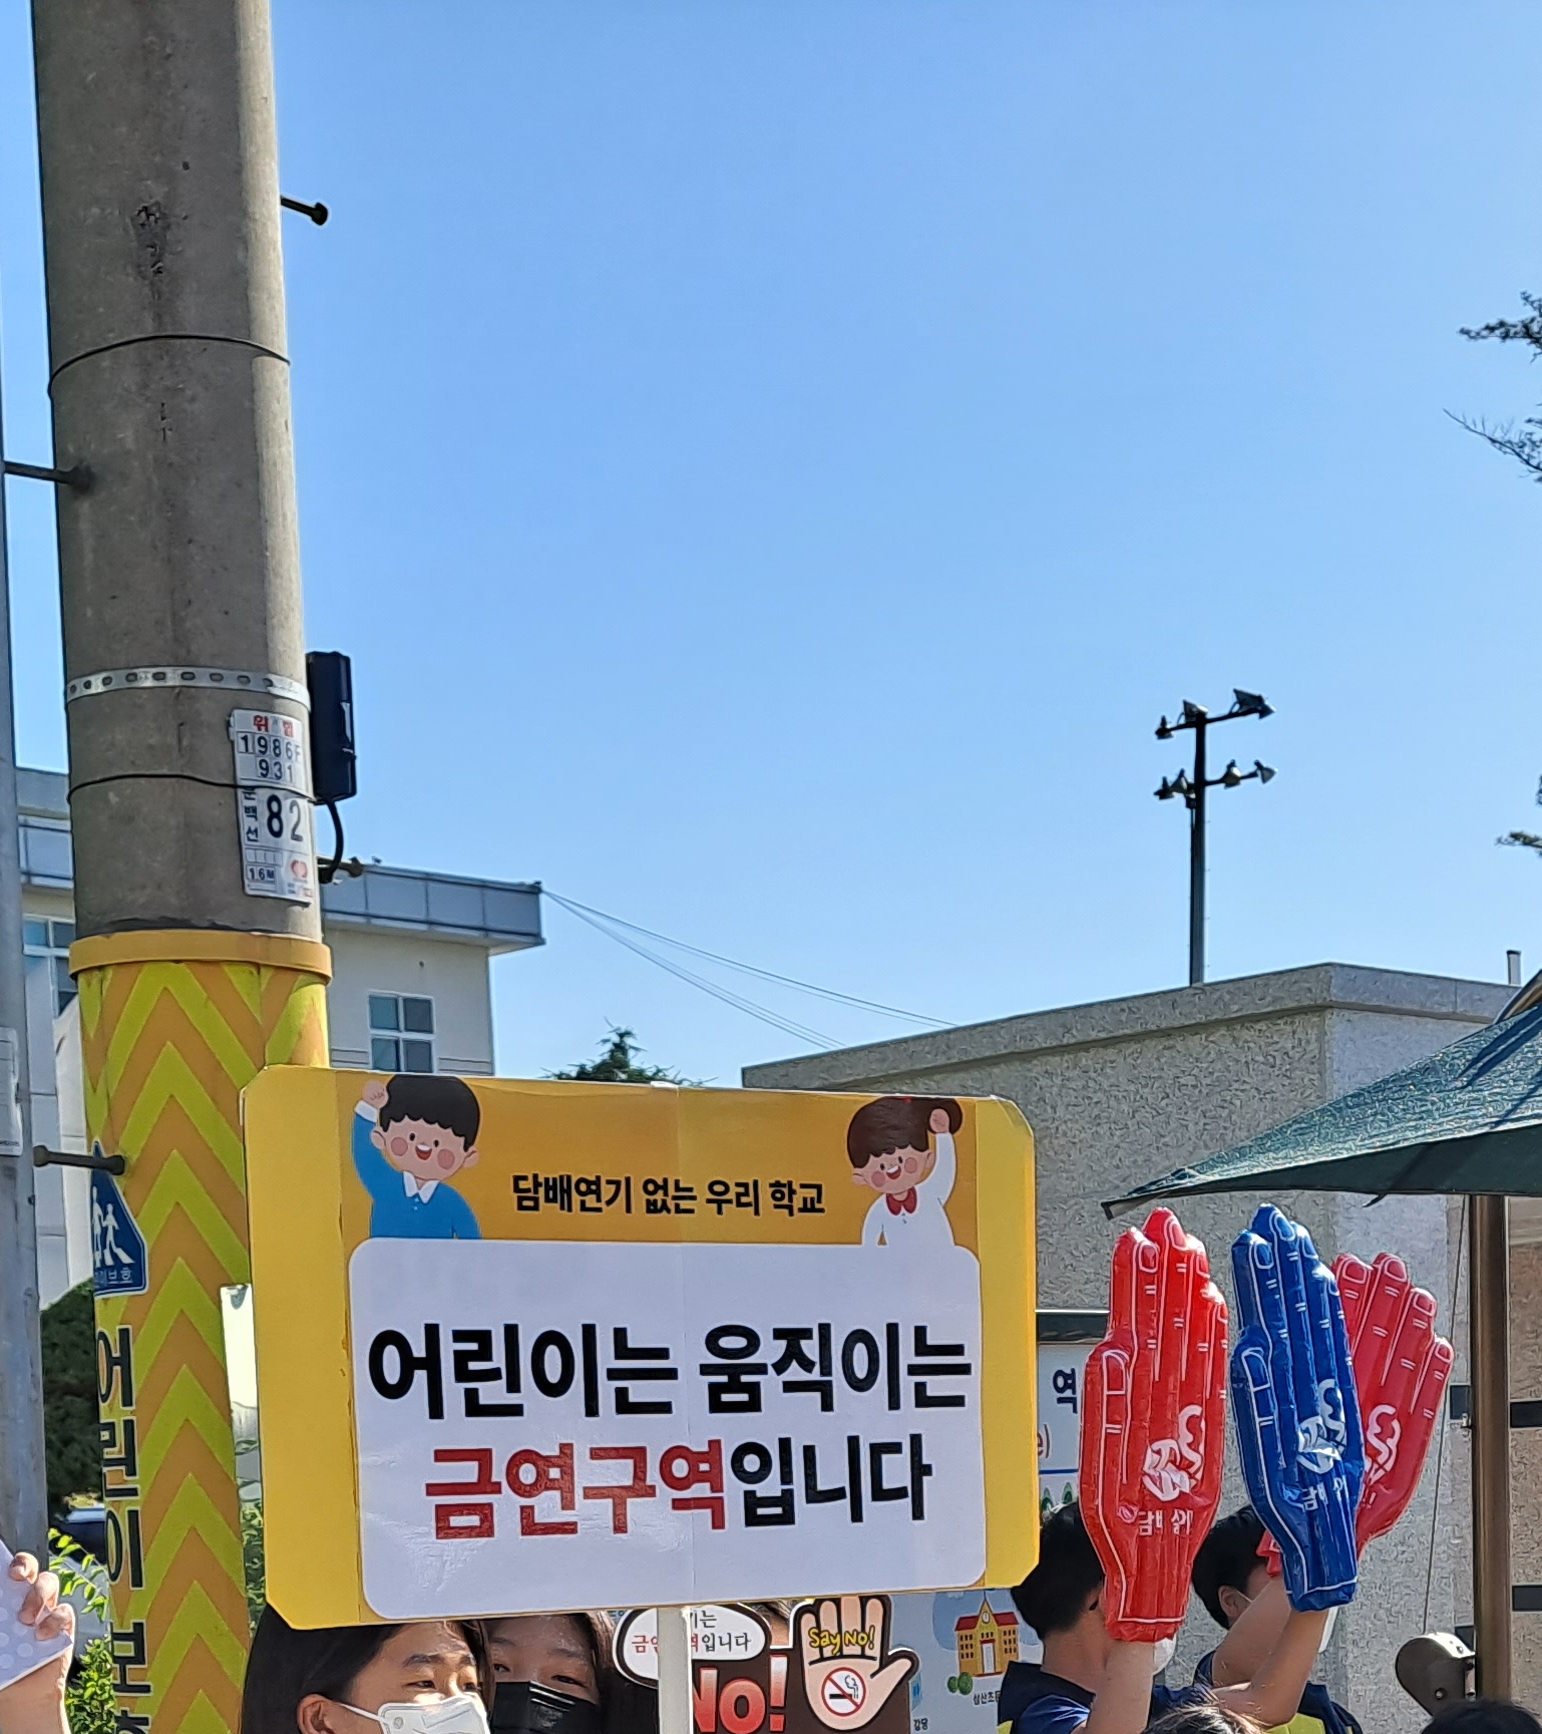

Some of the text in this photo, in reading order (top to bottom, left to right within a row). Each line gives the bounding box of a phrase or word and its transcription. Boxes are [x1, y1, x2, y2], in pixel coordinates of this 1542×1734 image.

[258, 758, 295, 784] 931
[267, 794, 303, 842] 82
[512, 1174, 827, 1217] 담배연기 없는 우리 학교
[367, 1321, 974, 1422] 어린이는 움직이는
[96, 1325, 144, 1590] 어린이
[425, 1432, 934, 1541] 금연구역입니다
[808, 1627, 841, 1655] Say
